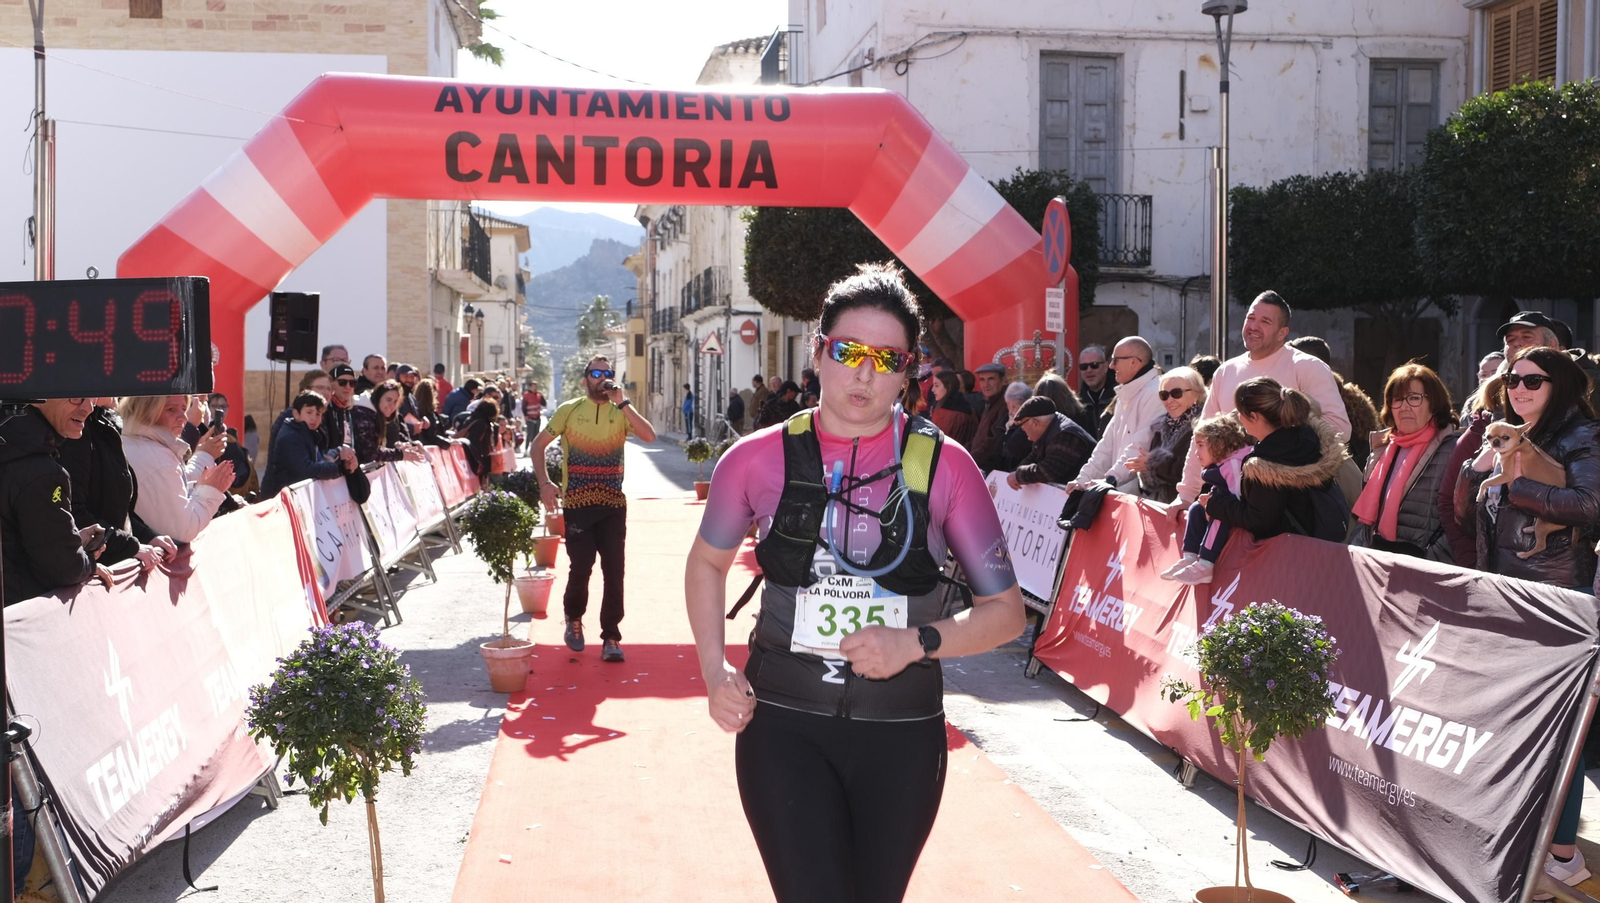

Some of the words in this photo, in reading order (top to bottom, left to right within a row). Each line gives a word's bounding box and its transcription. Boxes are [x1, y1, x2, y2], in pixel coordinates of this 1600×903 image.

[434, 85, 791, 122] AYUNTAMIENTO
[445, 131, 778, 189] CANTORIA
[809, 587, 821, 596] LA
[824, 587, 871, 599] PÓLVORA
[828, 577, 853, 588] CxM
[817, 604, 886, 637] 335
[1068, 584, 1144, 636] TEAMERGY
[85, 703, 188, 822] TEAMERGY
[1329, 755, 1417, 807] www.teamergy.es
